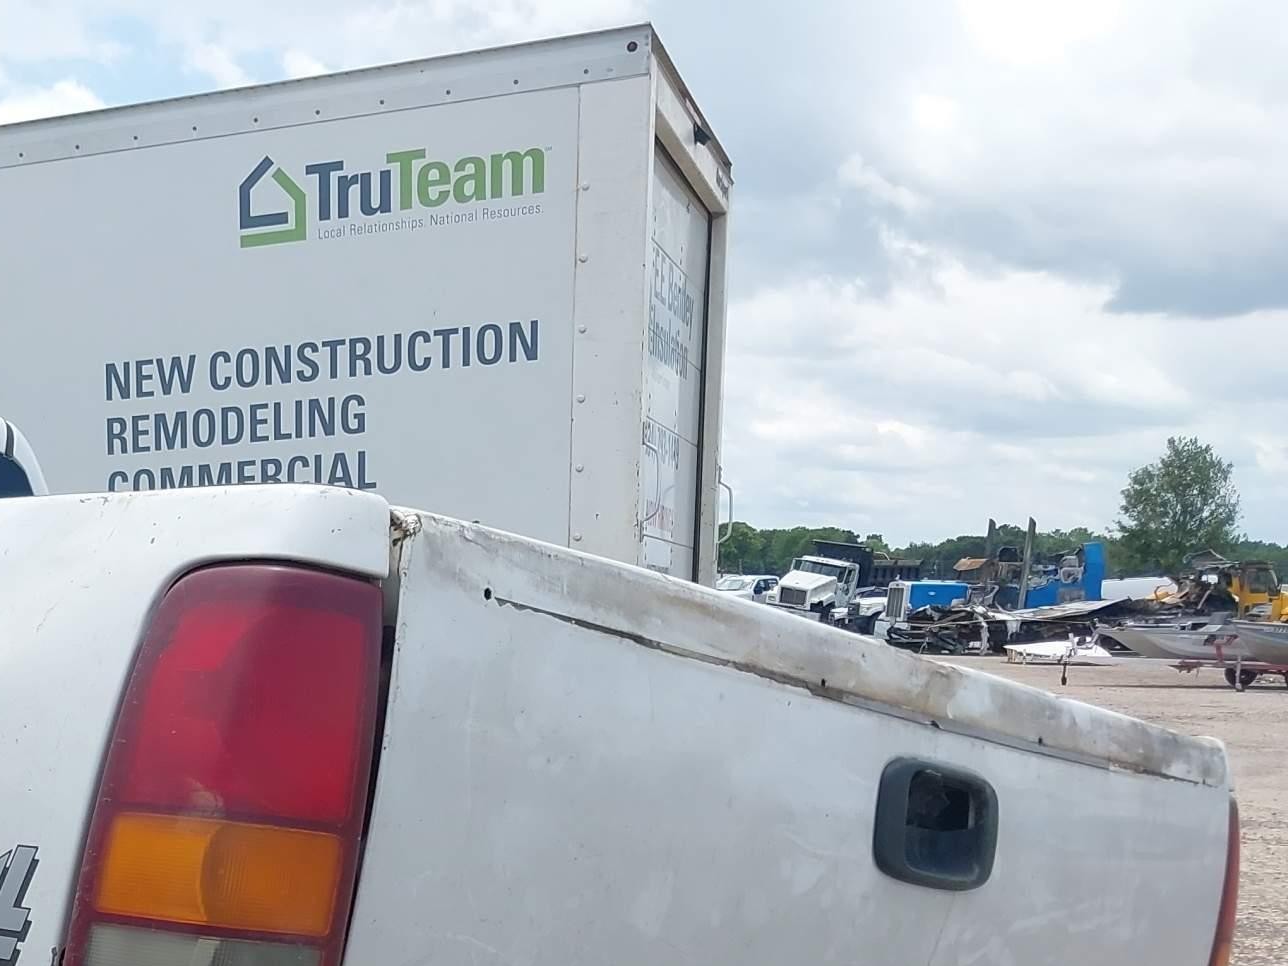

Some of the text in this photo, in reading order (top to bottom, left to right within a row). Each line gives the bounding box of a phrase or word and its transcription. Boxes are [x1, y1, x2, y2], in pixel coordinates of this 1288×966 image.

[305, 147, 545, 222] TruTeam
[317, 204, 545, 240] Local Relationships. National Resources.
[104, 319, 540, 401] NEW CONSTRUCTION
[106, 393, 367, 456] REMODELING
